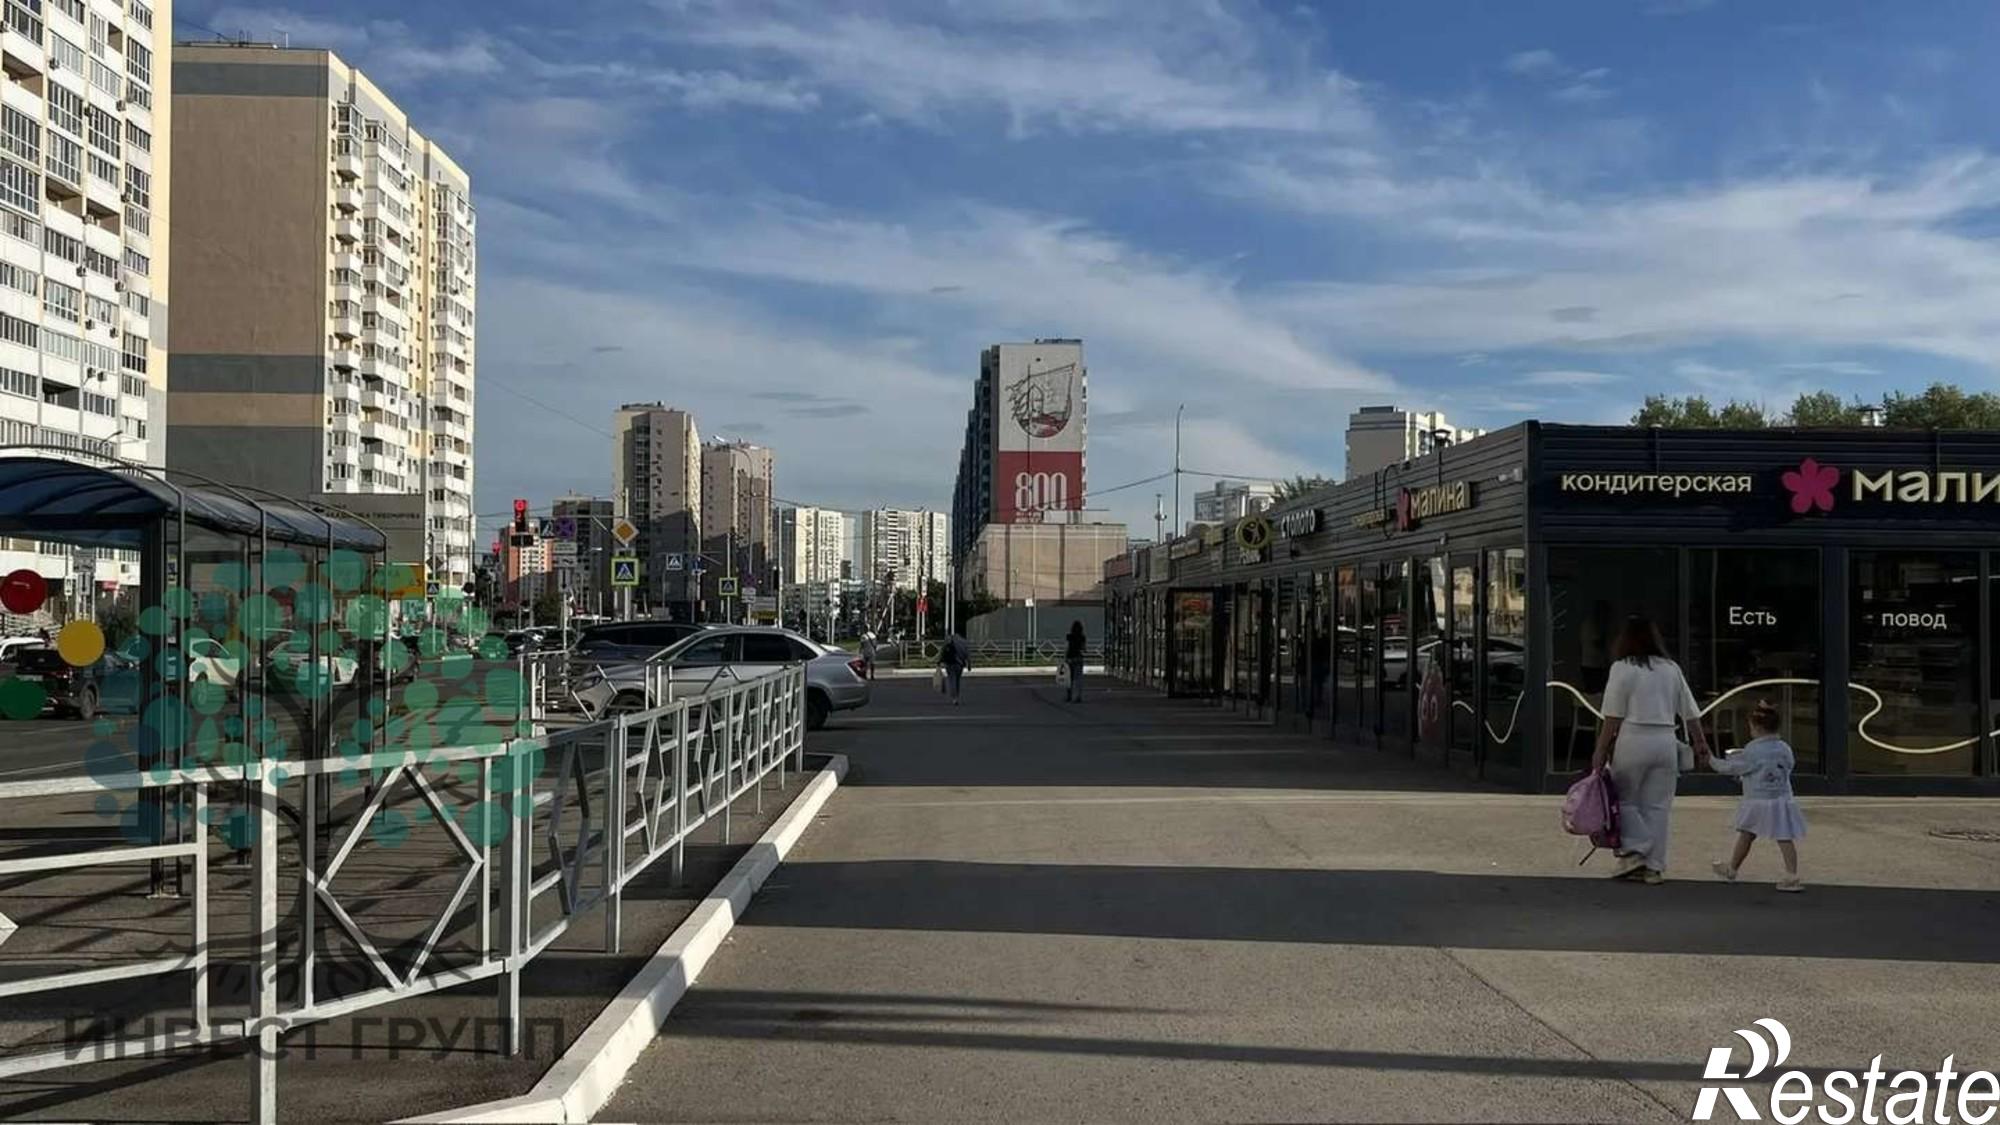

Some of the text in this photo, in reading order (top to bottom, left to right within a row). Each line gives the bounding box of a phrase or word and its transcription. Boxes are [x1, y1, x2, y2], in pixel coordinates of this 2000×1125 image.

[1015, 471, 1067, 512] 800
[1561, 469, 2000, 503] кондитерская мали
[1729, 606, 1948, 630] Есть повод
